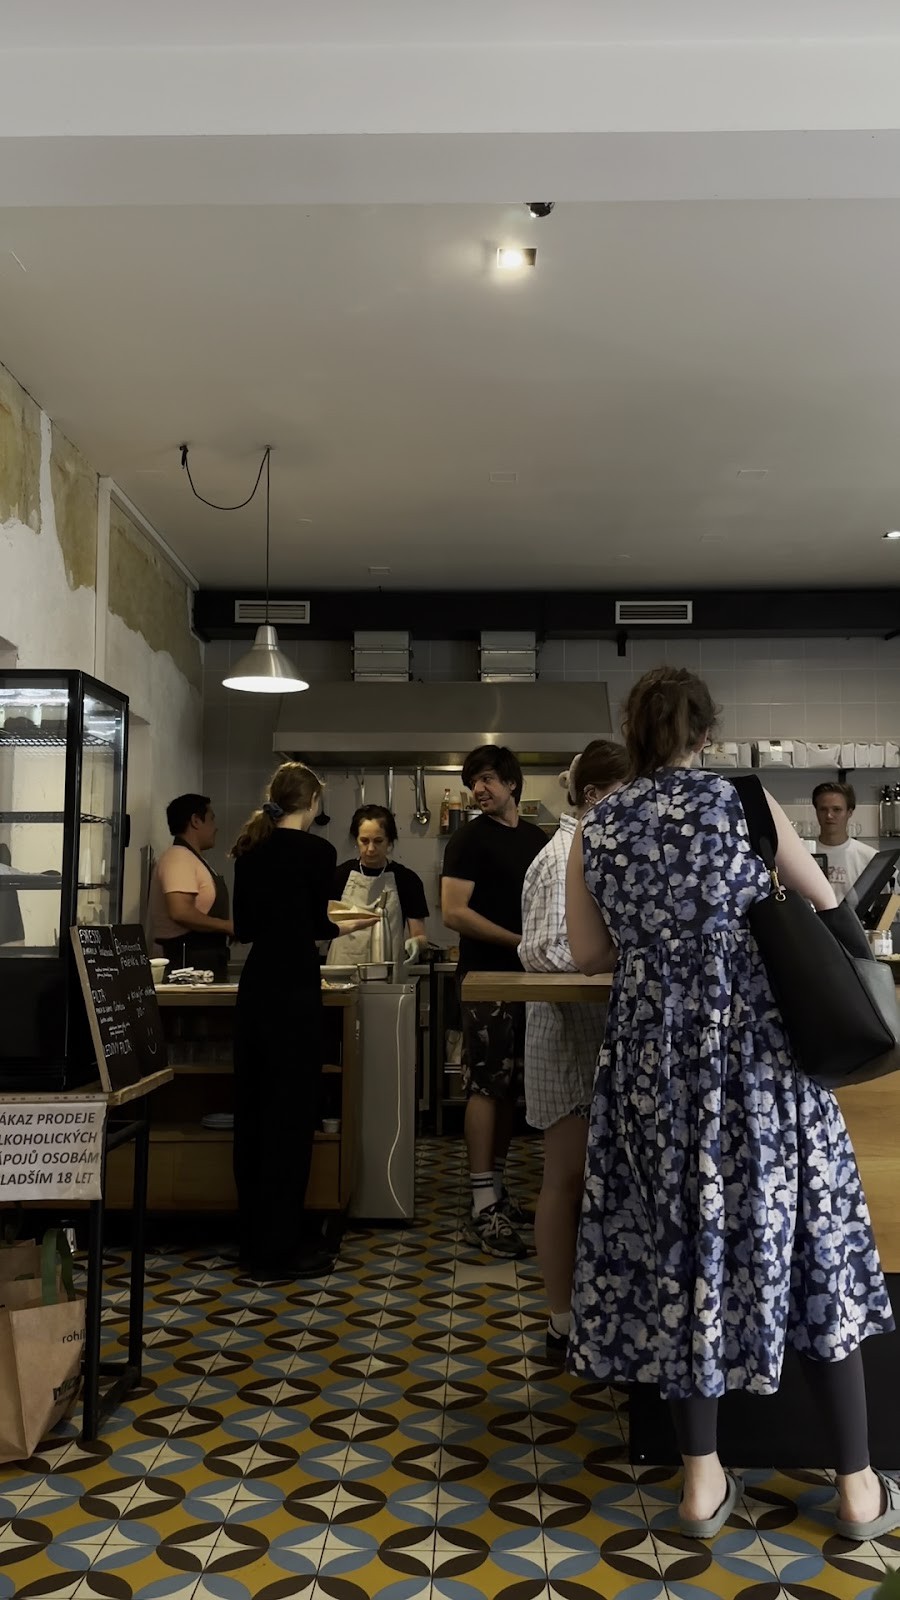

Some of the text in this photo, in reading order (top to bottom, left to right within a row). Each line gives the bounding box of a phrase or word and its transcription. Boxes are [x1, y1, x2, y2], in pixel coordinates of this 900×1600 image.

[0, 1112, 96, 1125] ÁKAZ PRODEJE
[0, 1149, 99, 1165] POJŮ OSOBÁM
[57, 1172, 72, 1183] 18
[75, 1172, 94, 1184] LET
